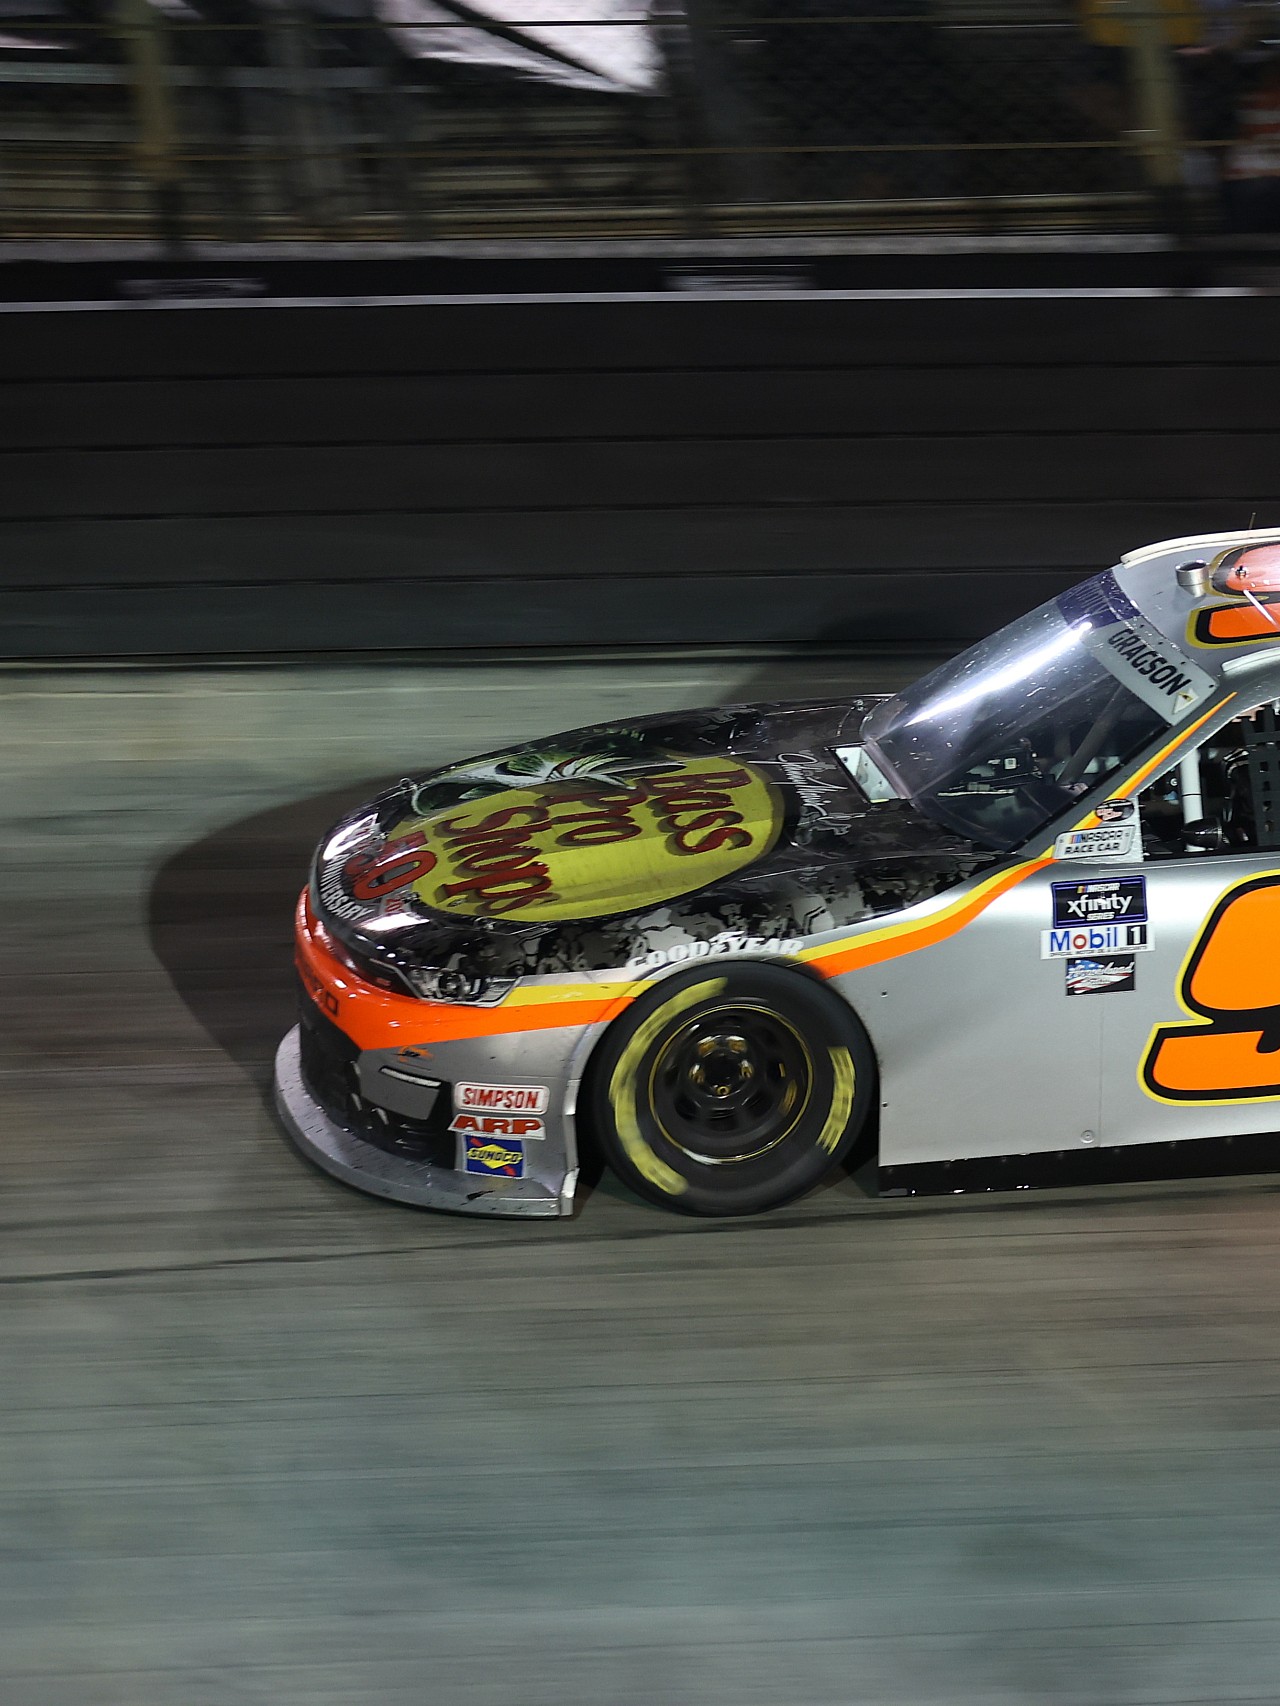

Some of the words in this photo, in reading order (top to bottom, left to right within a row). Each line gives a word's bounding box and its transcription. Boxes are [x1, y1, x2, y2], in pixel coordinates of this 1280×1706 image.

[1107, 628, 1192, 696] GRAGSON
[537, 783, 648, 847] Pro
[638, 769, 753, 856] Bass
[1065, 845, 1095, 855] RACE
[1097, 842, 1120, 852] CAR
[1081, 830, 1123, 843] NASCAR
[434, 805, 557, 916] Shops
[1067, 893, 1133, 917] xfinity
[625, 930, 804, 970] GOODYEAR
[1050, 926, 1119, 952] Mobil
[1128, 925, 1144, 946] 1
[463, 1087, 540, 1109] SIMPSON
[453, 1115, 542, 1135] ARP
[470, 1148, 522, 1164] SUNOCO
